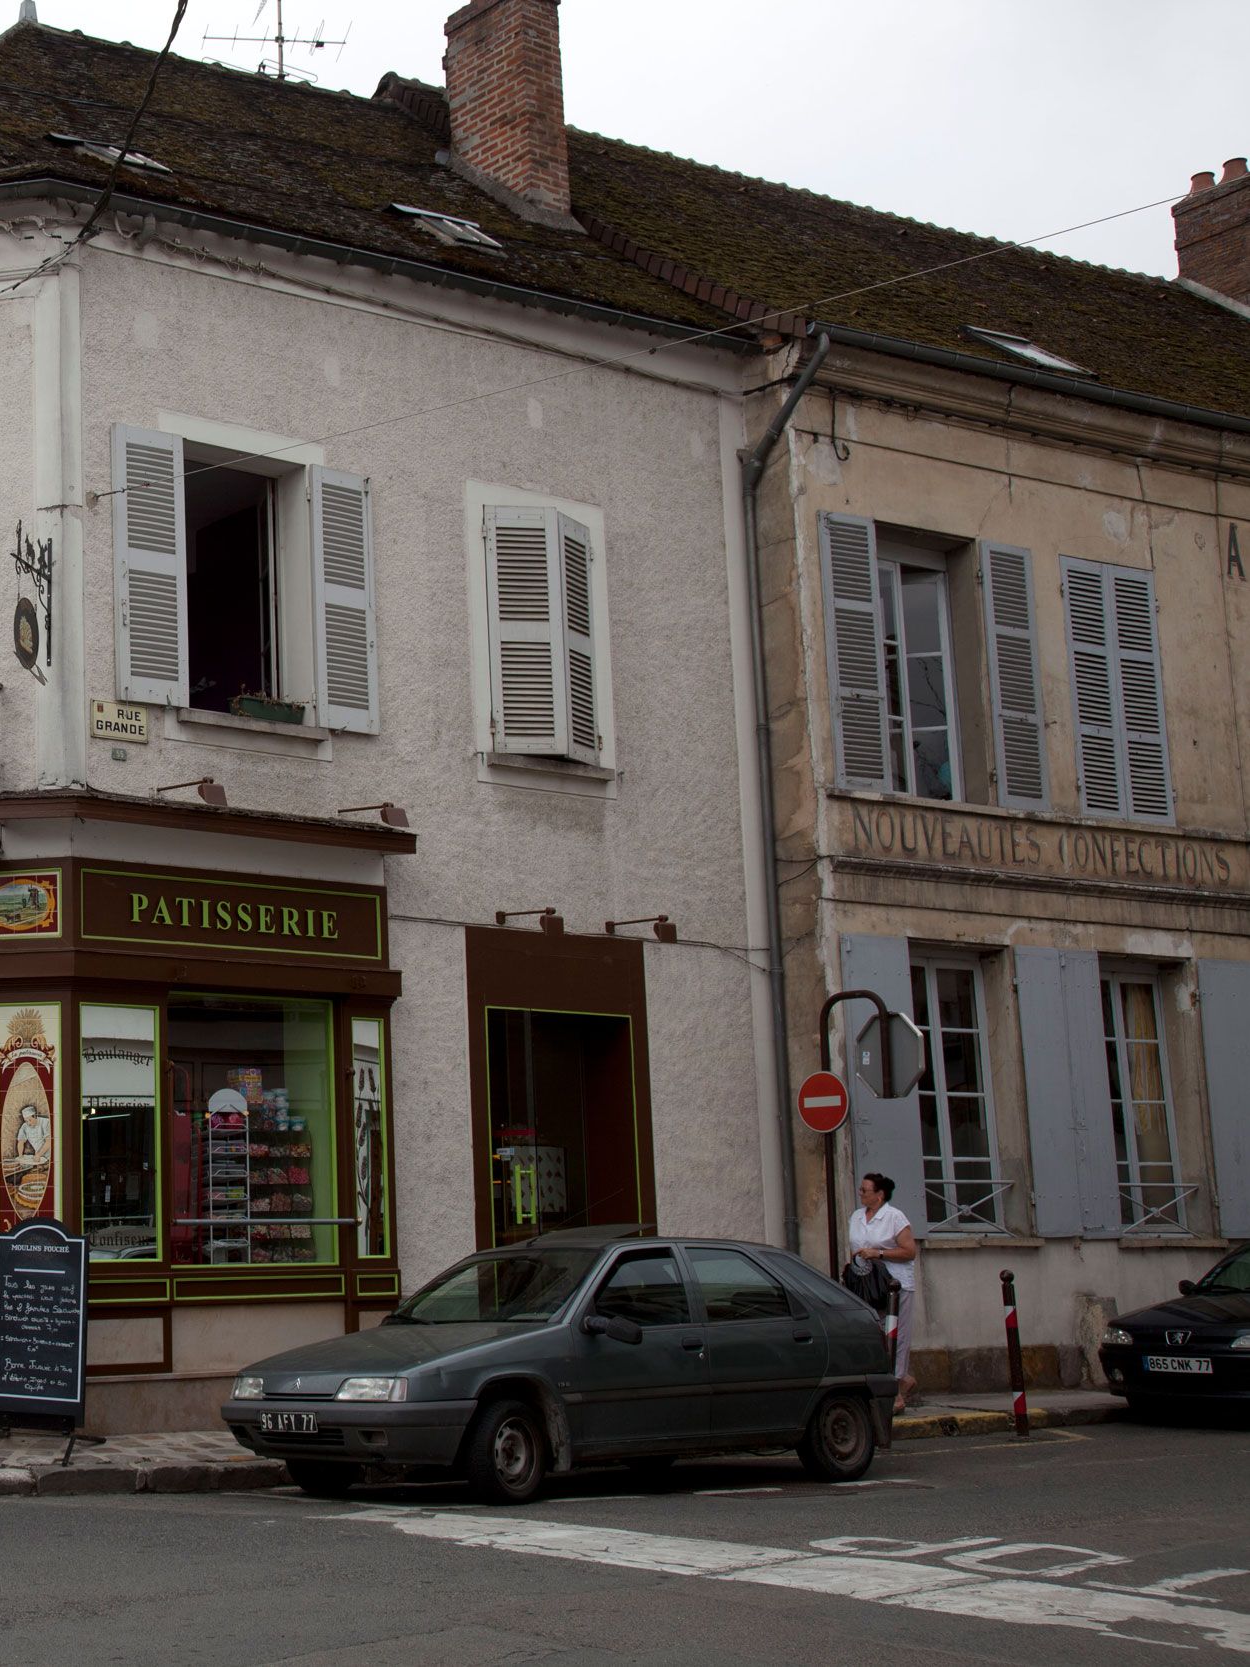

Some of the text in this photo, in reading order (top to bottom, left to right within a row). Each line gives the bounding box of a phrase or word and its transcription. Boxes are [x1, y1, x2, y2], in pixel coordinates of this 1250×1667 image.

[117, 710, 142, 722] RUE
[96, 720, 145, 736] GRANDE
[130, 892, 339, 940] PATISSERIE
[82, 1045, 154, 1066] Boulanger
[11, 1244, 42, 1252] MOULINS
[1149, 1358, 1210, 1372] 865 CNK 77
[302, 1414, 314, 1431] 77
